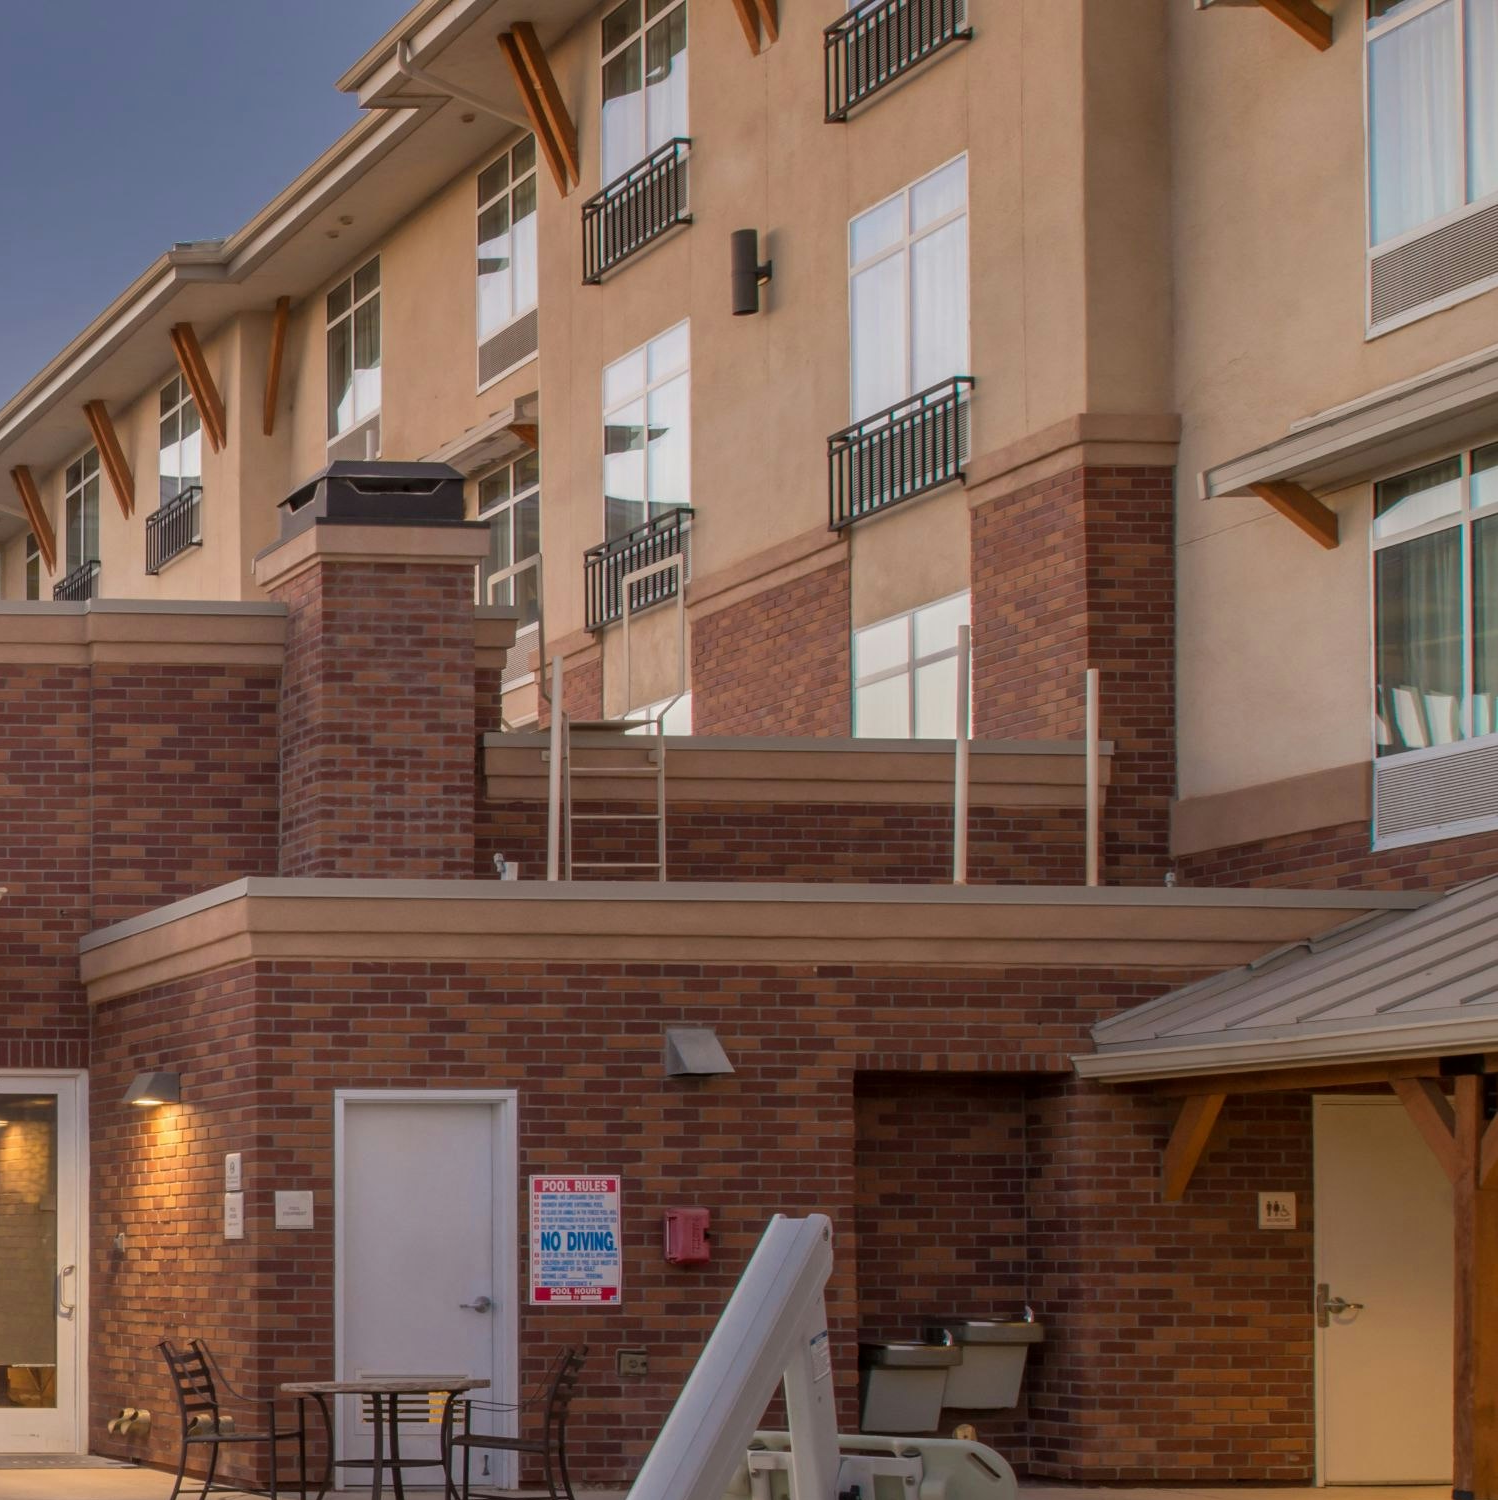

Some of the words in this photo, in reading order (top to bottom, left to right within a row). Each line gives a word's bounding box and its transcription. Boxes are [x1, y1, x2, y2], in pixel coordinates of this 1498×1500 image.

[542, 1180, 571, 1192] POOL
[574, 1180, 608, 1192] RULES
[541, 1231, 561, 1251] NO
[567, 1231, 618, 1251] DIVING.
[550, 1287, 571, 1295] POOL
[574, 1287, 602, 1295] HOURS
